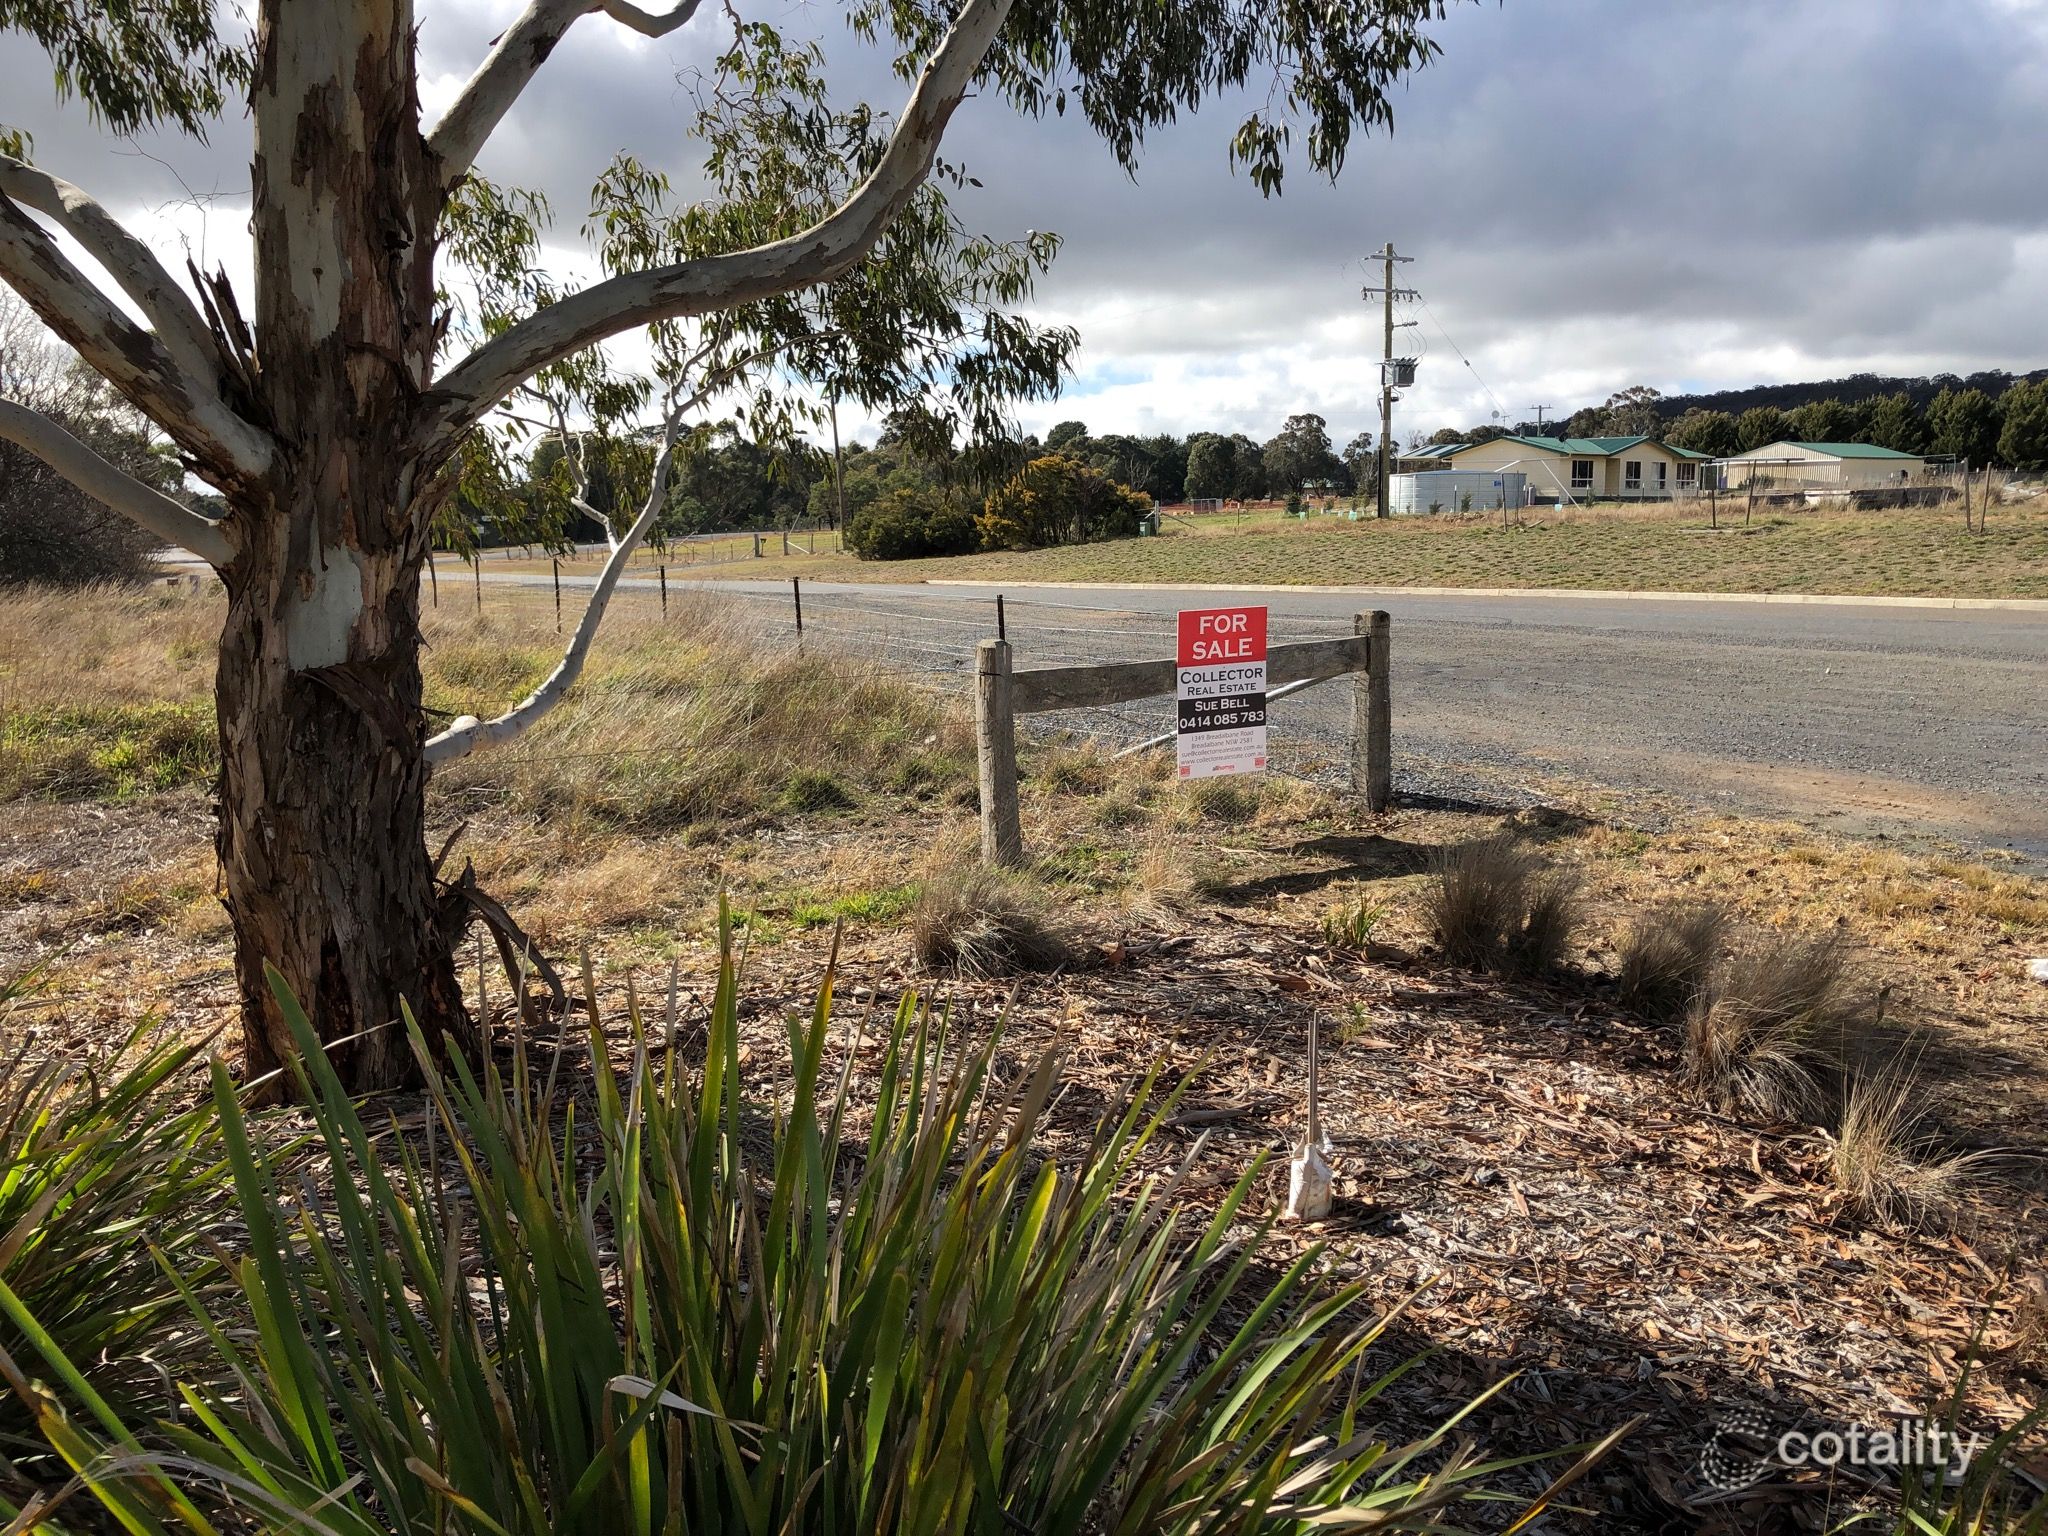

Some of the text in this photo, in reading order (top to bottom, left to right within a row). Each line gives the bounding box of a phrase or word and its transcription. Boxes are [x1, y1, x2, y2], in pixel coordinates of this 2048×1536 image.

[1199, 613, 1247, 635] FOR
[1192, 637, 1253, 660] SALE
[1180, 667, 1263, 684] COLLECTOR
[1187, 682, 1256, 696] REAL ESTATE
[1194, 698, 1250, 711] SUE BELL
[1180, 710, 1264, 729] 0414 085 783
